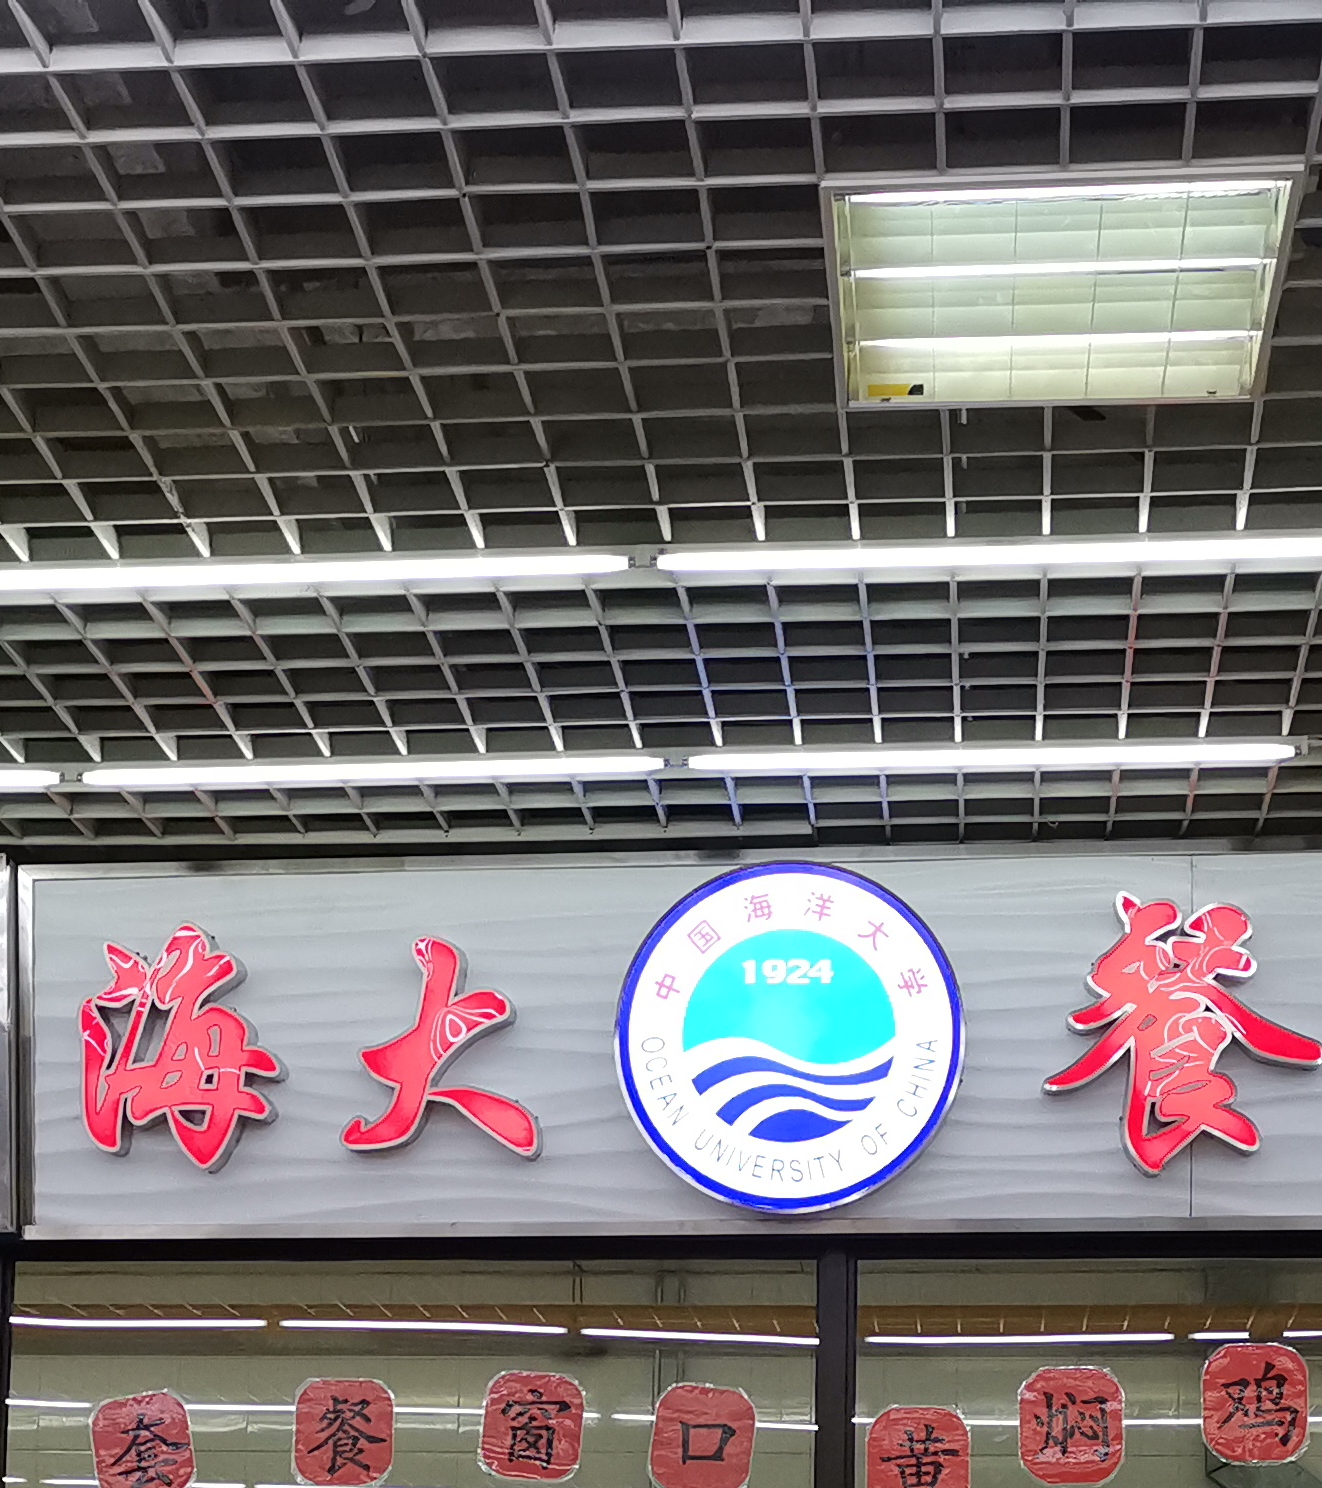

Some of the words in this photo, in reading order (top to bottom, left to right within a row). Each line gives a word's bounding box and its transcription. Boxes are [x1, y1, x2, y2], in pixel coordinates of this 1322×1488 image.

[654, 891, 928, 1000] 中国海洋大学
[741, 959, 835, 985] 1924
[641, 1036, 689, 1127] OCEAN
[694, 1128, 843, 1184] UNIVERSITY
[860, 1123, 889, 1156] OF
[896, 1038, 938, 1119] CHINA
